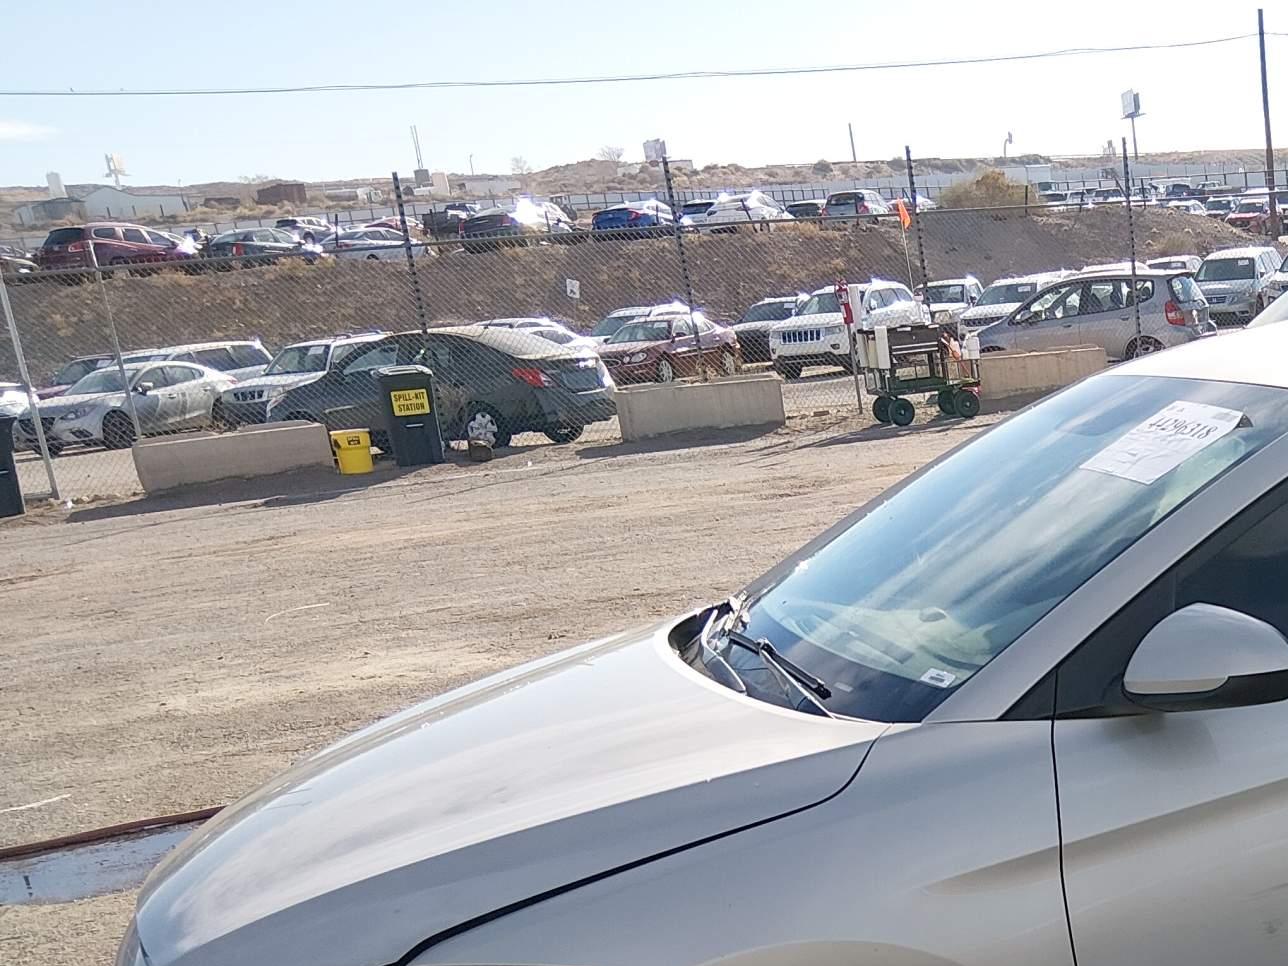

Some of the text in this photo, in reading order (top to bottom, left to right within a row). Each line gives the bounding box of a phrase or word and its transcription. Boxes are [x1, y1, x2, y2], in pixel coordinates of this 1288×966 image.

[393, 392, 426, 402] SPILL-KIT
[398, 402, 425, 413] STATION
[1149, 416, 1218, 439] 44296318
